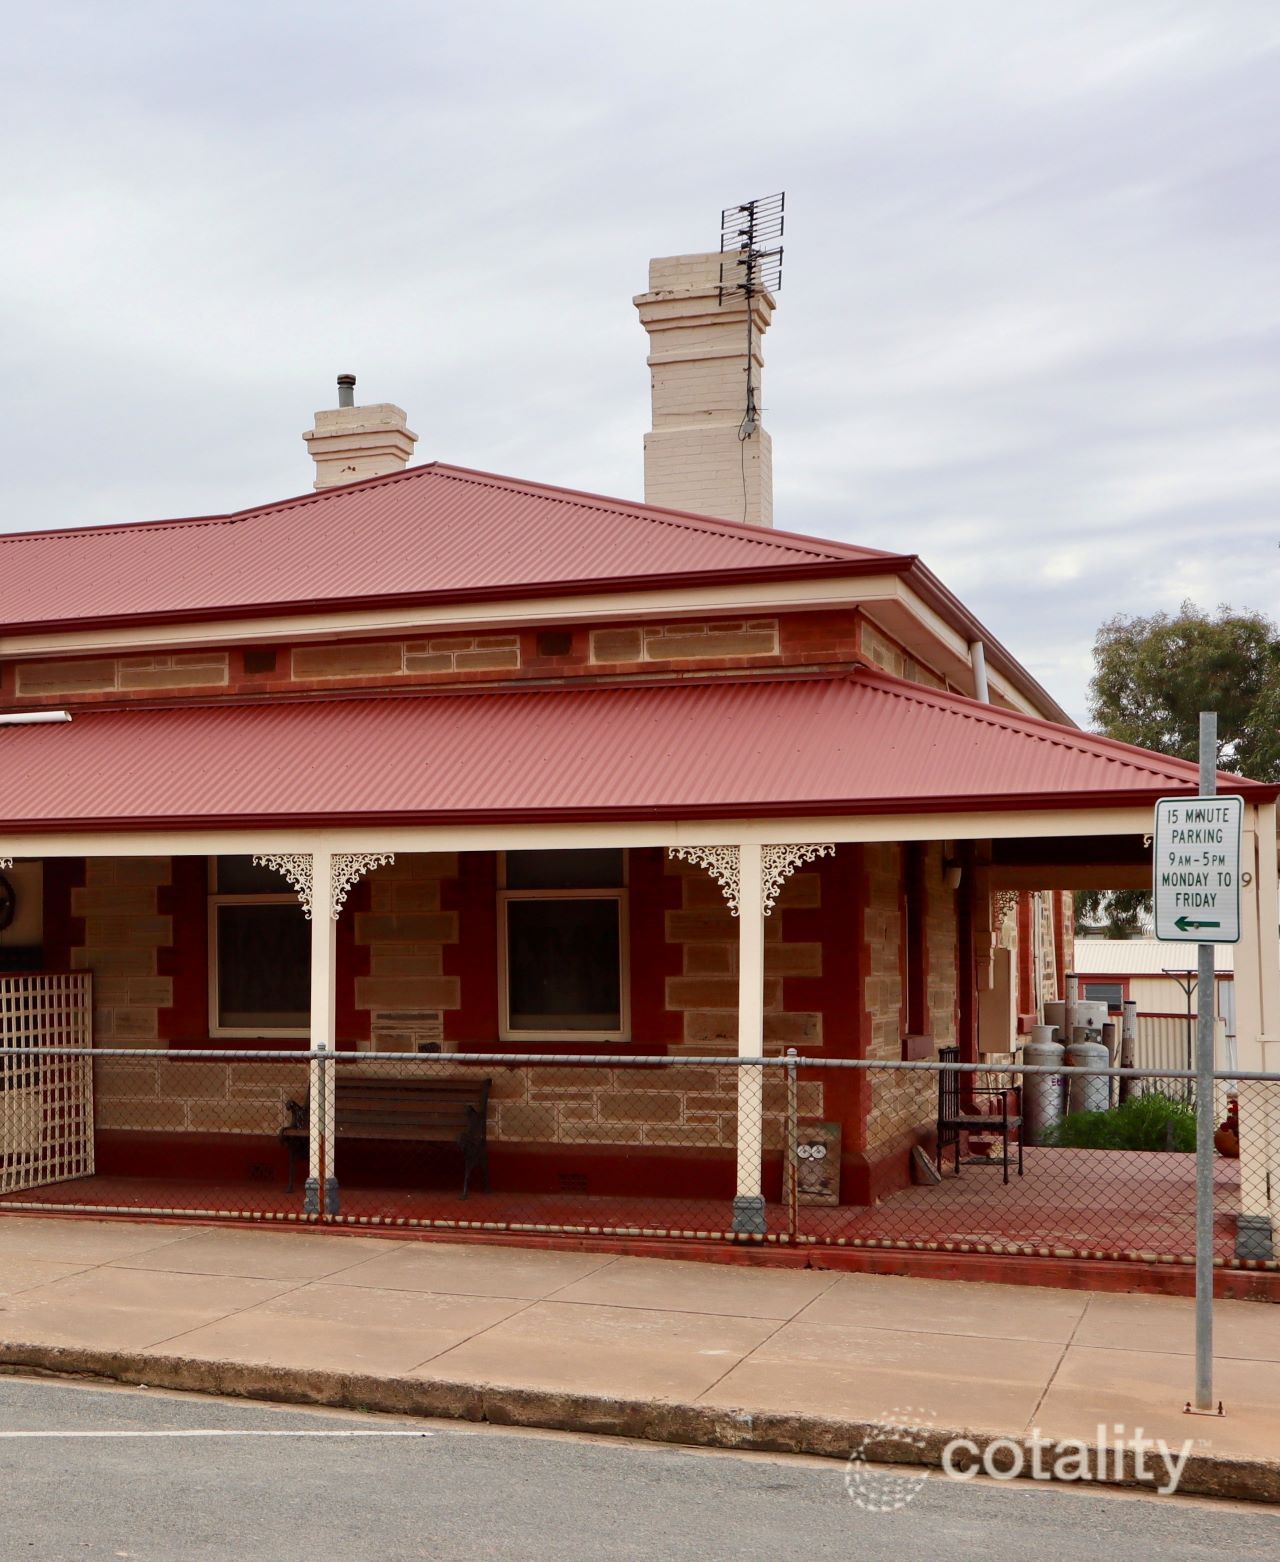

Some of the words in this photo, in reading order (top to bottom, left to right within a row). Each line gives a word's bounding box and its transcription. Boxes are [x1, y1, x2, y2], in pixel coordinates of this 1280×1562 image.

[1167, 809, 1179, 824] 15
[1185, 808, 1230, 824] MINUTE
[1171, 829, 1223, 844] PARKING
[1161, 872, 1209, 887] MONDAY
[1217, 872, 1232, 887] TO
[1241, 872, 1253, 888] 9
[1175, 892, 1217, 908] FRIDAY
